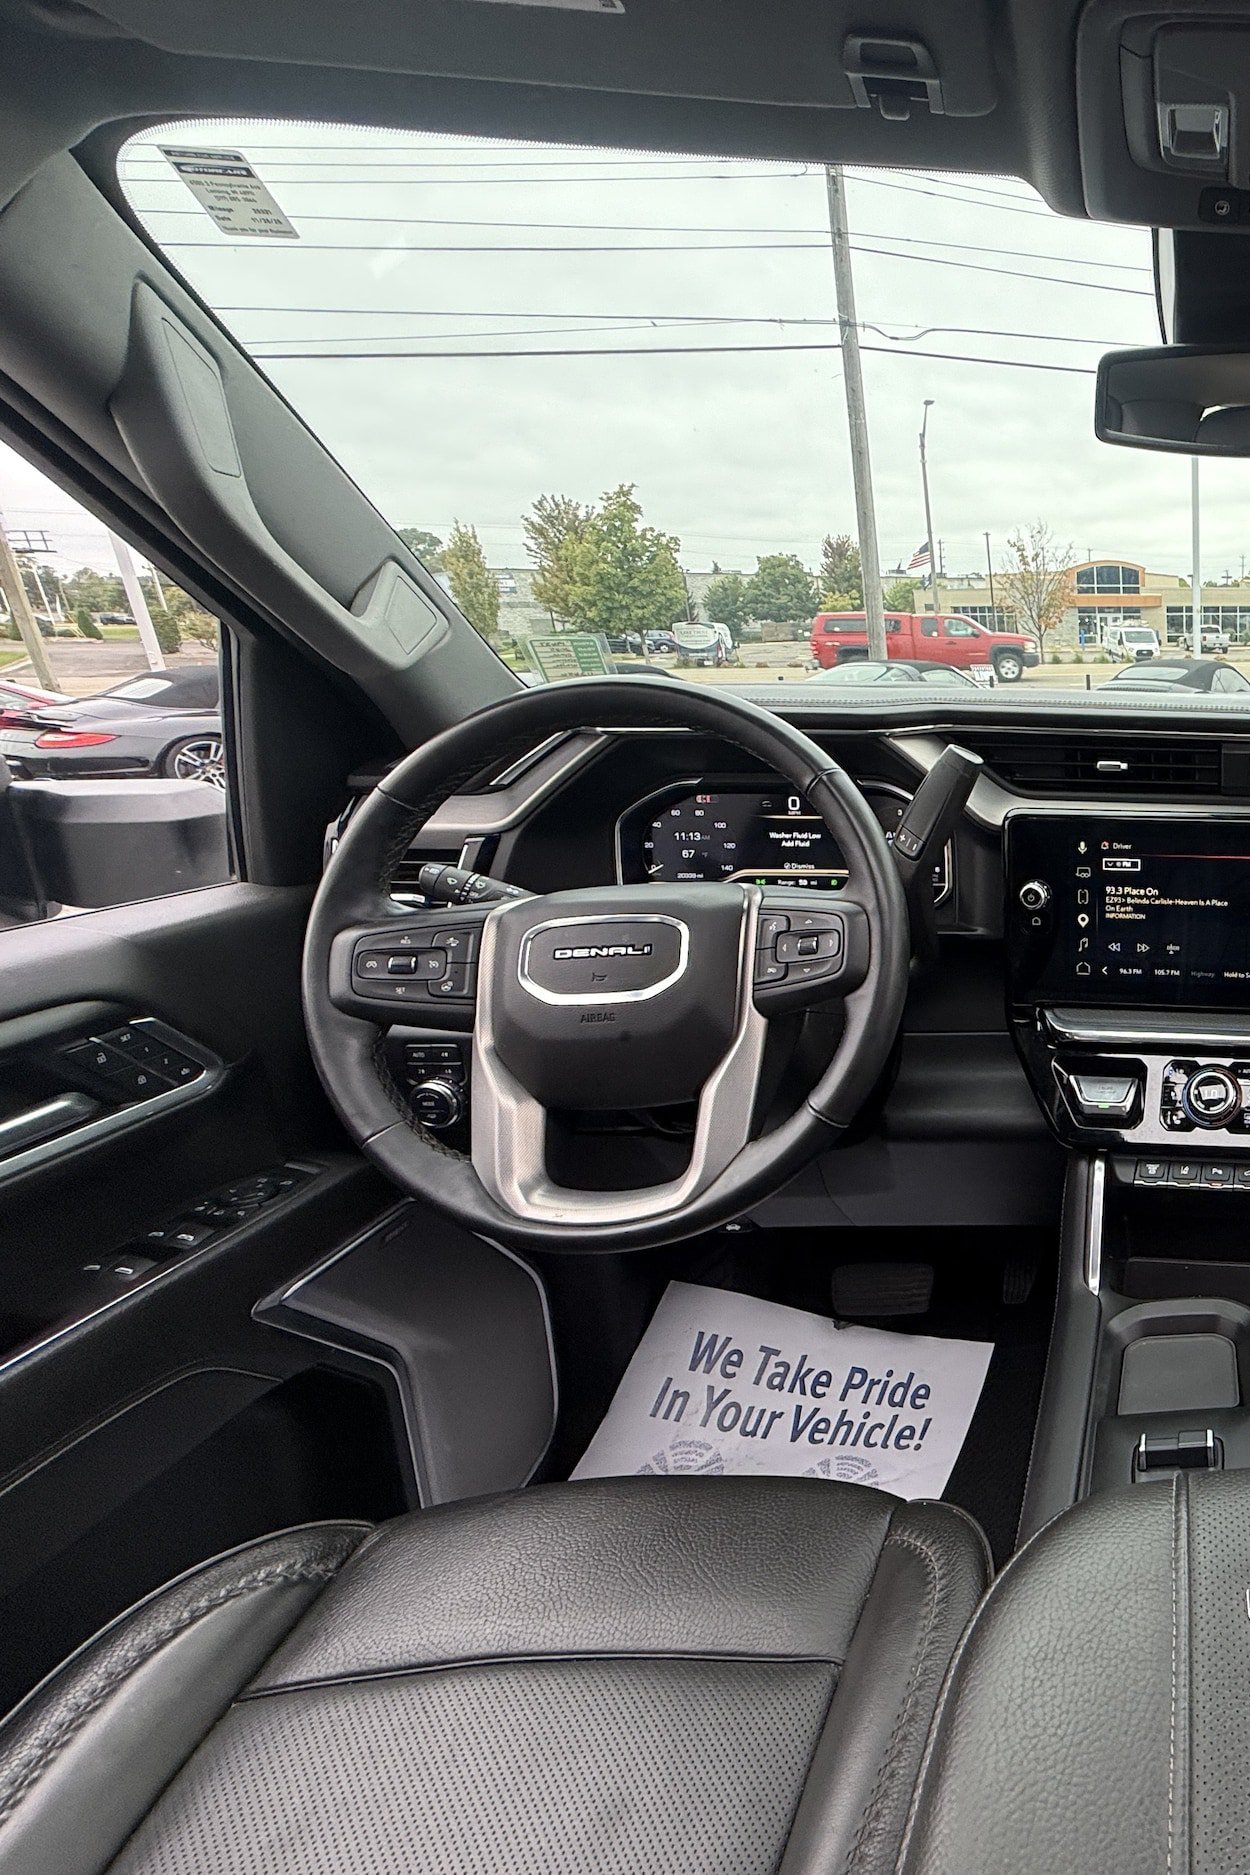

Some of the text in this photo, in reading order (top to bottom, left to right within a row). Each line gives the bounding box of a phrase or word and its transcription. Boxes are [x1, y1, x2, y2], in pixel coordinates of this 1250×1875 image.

[788, 796, 800, 811] 0
[674, 832, 701, 841] 11:13
[682, 849, 696, 858] 67
[1105, 886, 1159, 896] 93.3 Place On
[1127, 896, 1150, 904] Belinda
[1211, 899, 1229, 907] Place
[554, 944, 652, 960] DENALI
[580, 1012, 616, 1024] AIRBAG
[687, 1331, 931, 1410] We Take Pride
[649, 1376, 933, 1451] In Your Vehicle!
